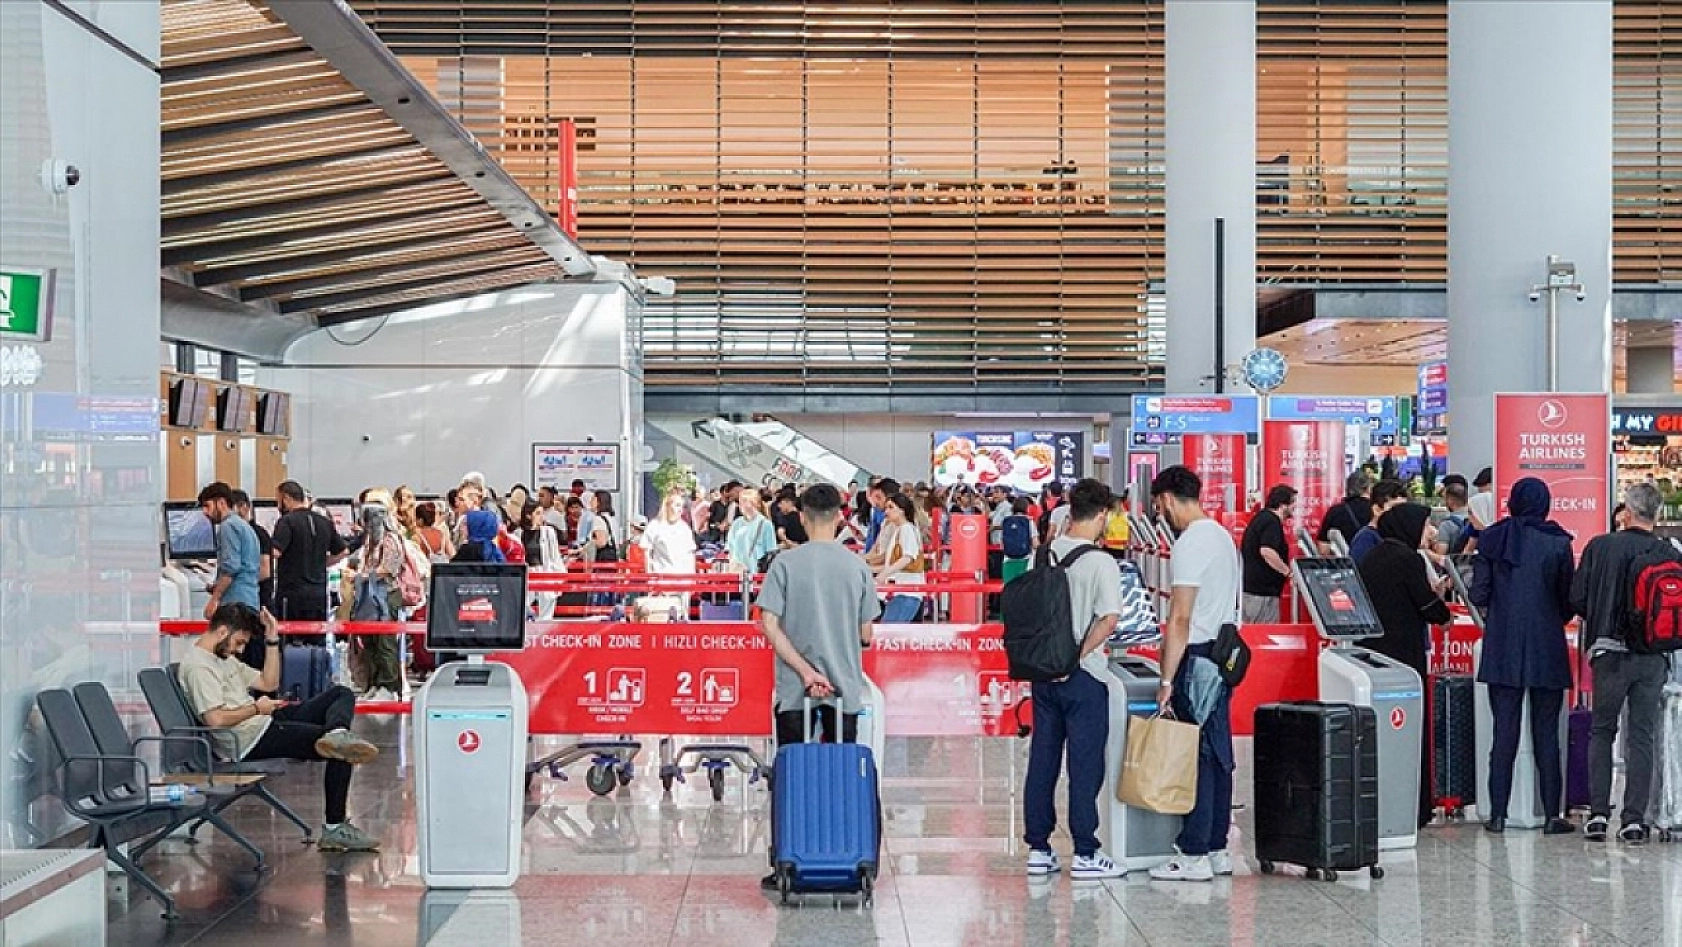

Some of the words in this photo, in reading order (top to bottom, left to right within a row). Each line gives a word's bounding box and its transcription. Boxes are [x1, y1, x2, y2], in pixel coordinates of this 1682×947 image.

[1165, 416, 1186, 429] F-S
[1625, 414, 1654, 431] MY
[1656, 414, 1682, 431] GI
[1519, 433, 1586, 446] TURKISH
[1519, 446, 1586, 460] AIRLINES
[1550, 497, 1597, 511] ECK-IN
[524, 634, 538, 648] ST
[542, 634, 602, 648] CHECK-IN
[608, 634, 642, 648] ZONE
[664, 634, 697, 649] HIZLI
[701, 634, 766, 650] CHECK-IN
[876, 638, 907, 651] FAST
[911, 638, 972, 651] CHECK-IN
[978, 638, 1005, 651] ZON
[583, 671, 597, 694] 1
[676, 671, 693, 695] 2
